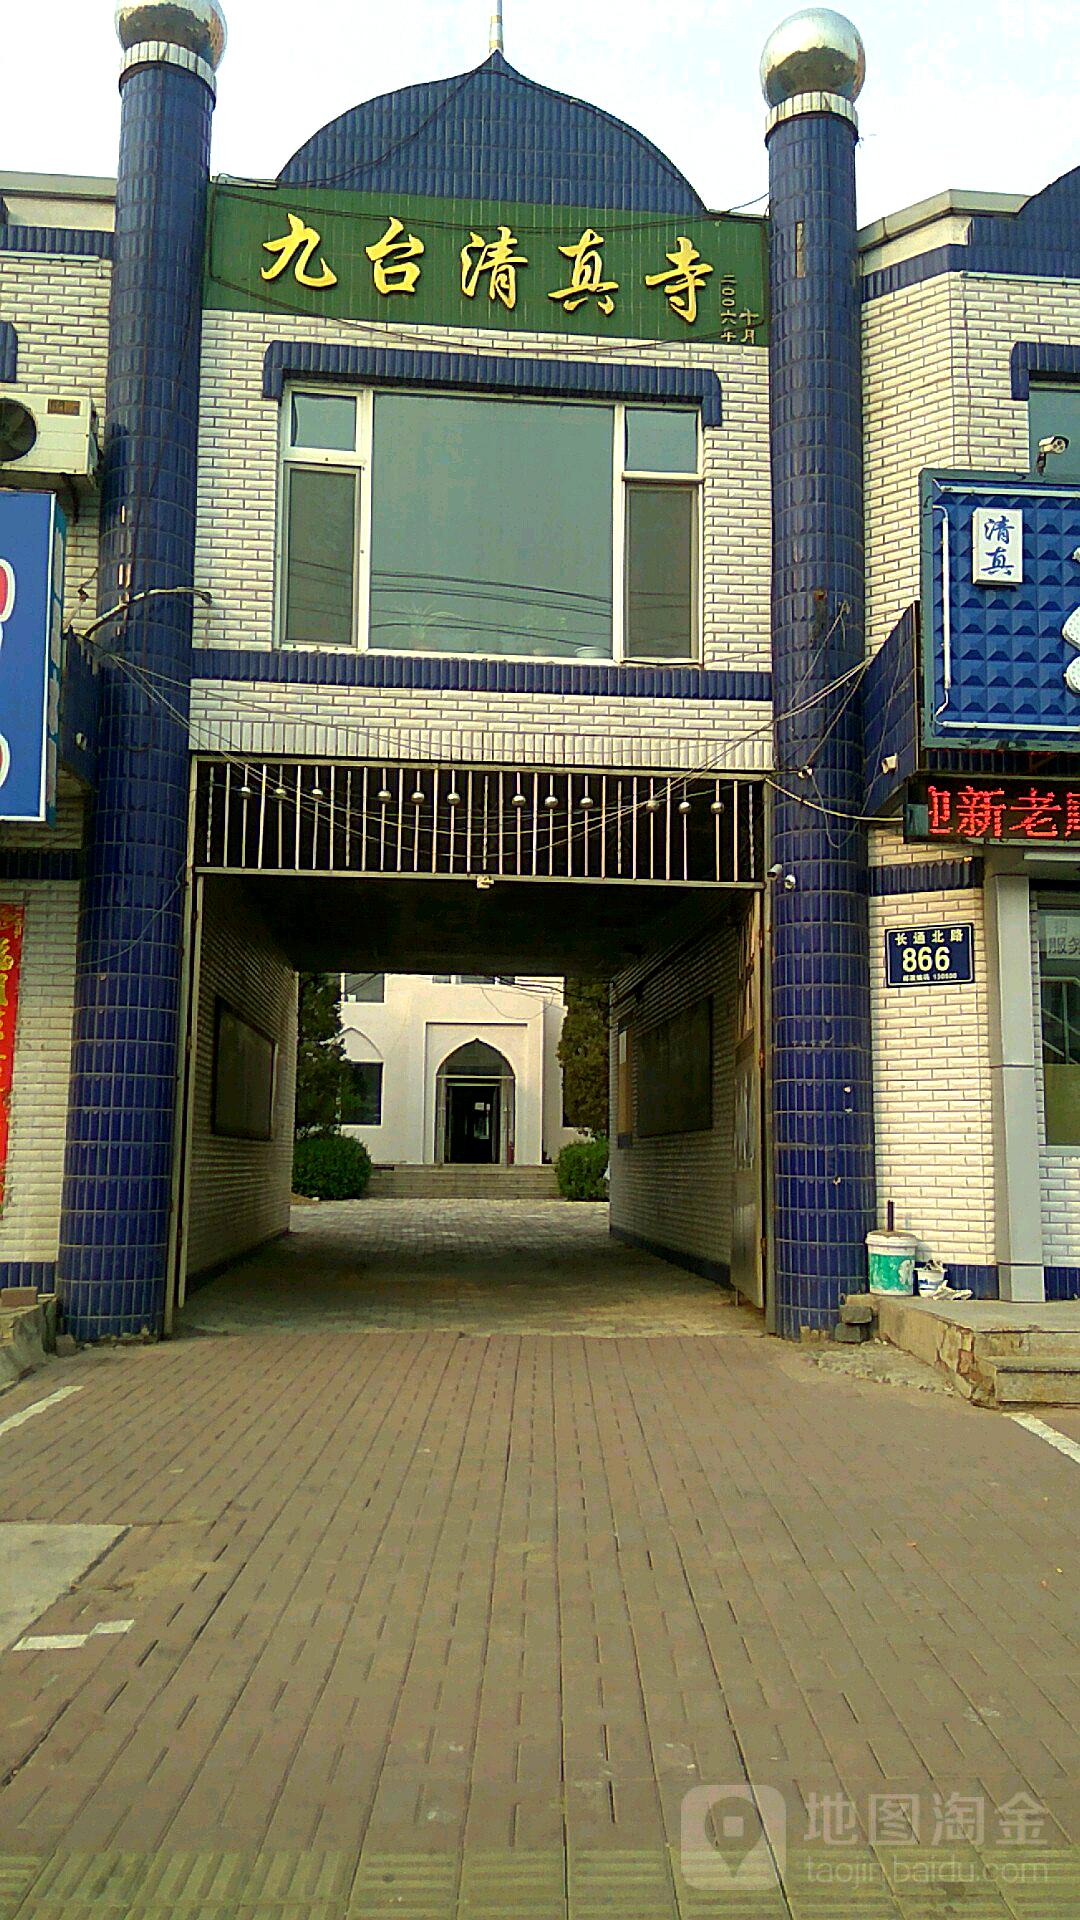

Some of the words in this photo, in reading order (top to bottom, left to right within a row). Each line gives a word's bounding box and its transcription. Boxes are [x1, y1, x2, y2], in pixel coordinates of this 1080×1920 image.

[261, 213, 713, 323] 九台清真寺
[739, 307, 760, 344] 十月
[982, 515, 1015, 576] 清真
[895, 929, 963, 946] 长通北路
[902, 946, 950, 972] 866
